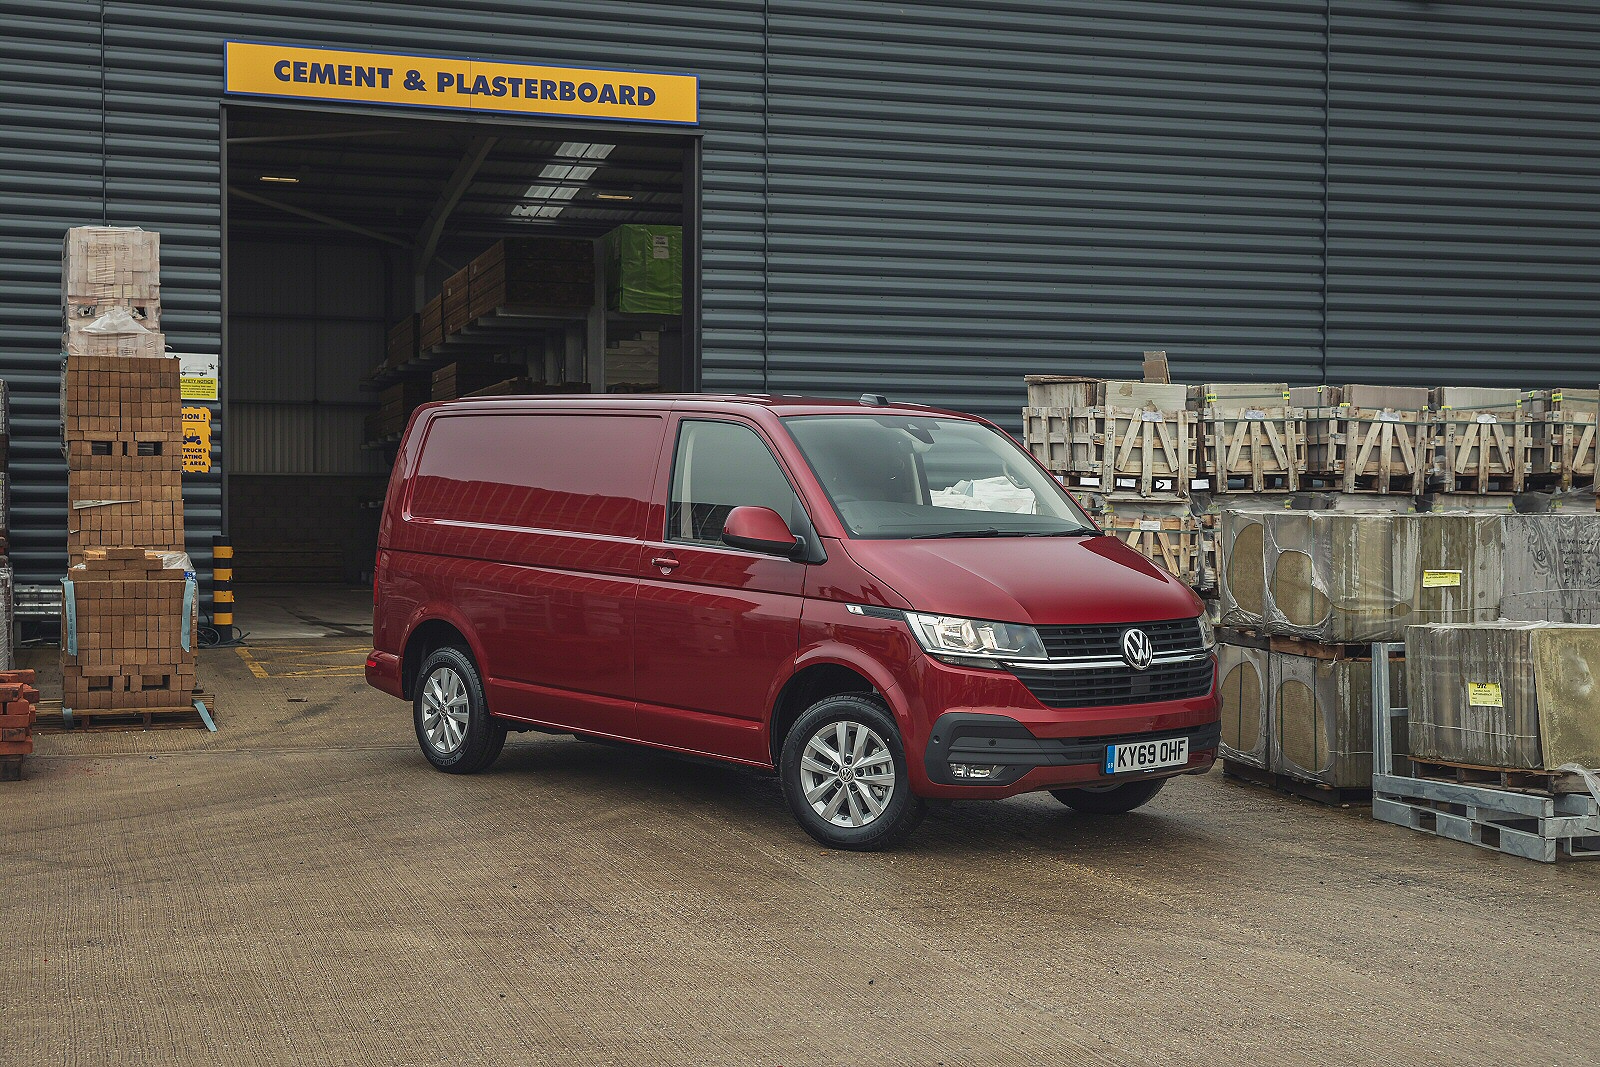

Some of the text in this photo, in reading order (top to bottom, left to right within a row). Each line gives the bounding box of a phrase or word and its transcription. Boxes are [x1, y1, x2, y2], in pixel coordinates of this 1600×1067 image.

[273, 59, 656, 107] CEMENT & PLASTERBOARD
[1117, 739, 1186, 768] KY69 OHF
